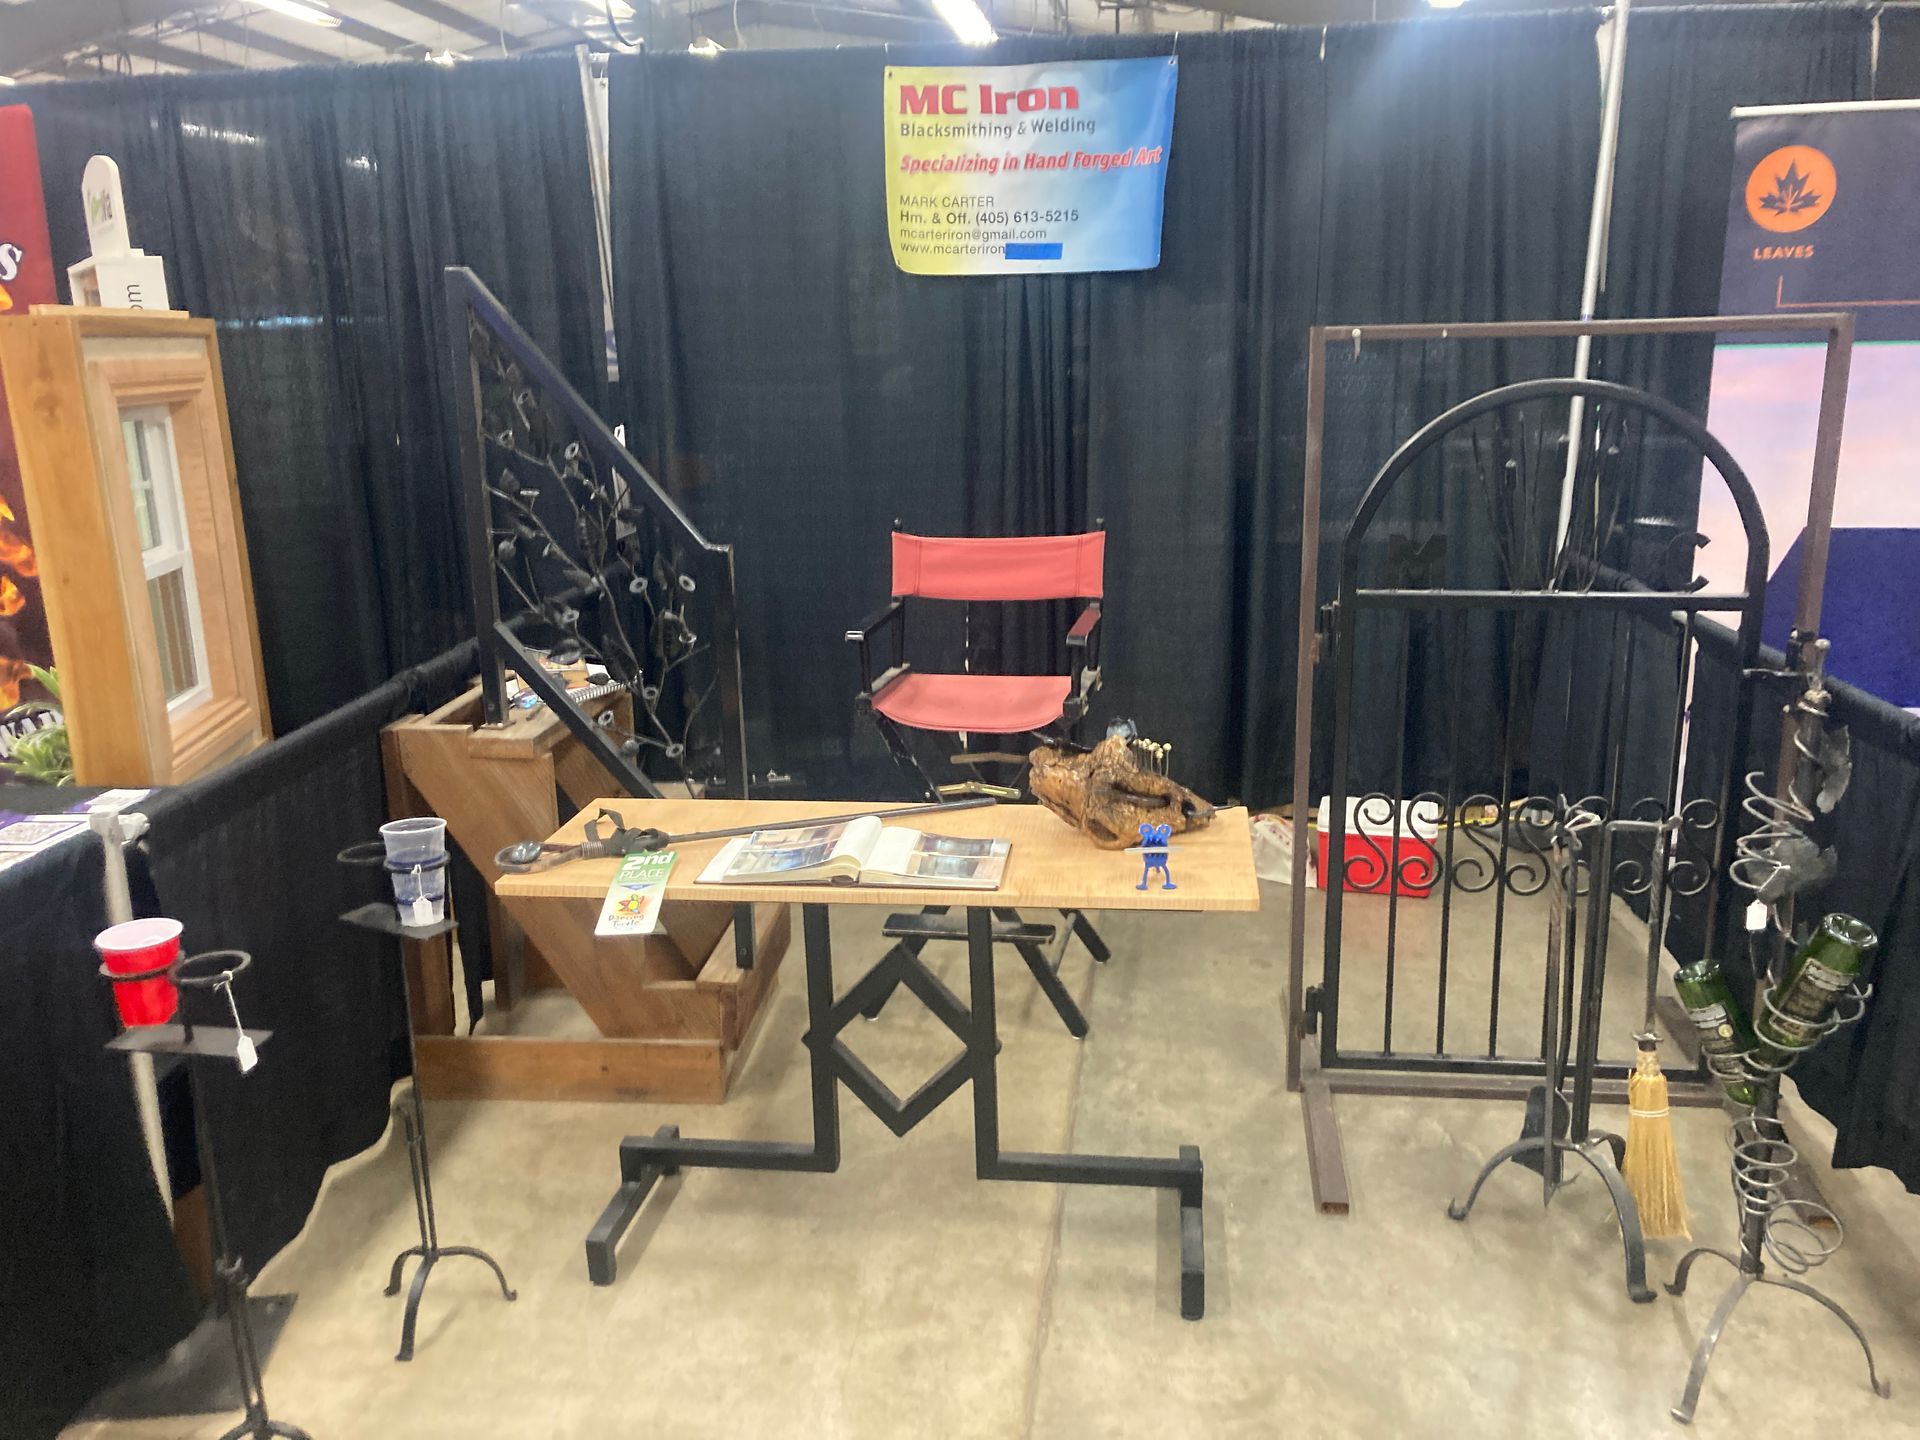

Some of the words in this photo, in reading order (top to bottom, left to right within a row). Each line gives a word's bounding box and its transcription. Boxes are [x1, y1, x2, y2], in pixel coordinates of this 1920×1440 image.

[900, 84, 967, 115] MC
[979, 84, 1080, 115] Iron
[901, 122, 1012, 139] Blacksmithing
[1017, 121, 1026, 135] &
[1031, 116, 1096, 135] Welding
[900, 152, 999, 176] Specializing
[1002, 151, 1019, 171] in
[1023, 151, 1069, 171] Hand
[1073, 147, 1132, 172] Forged
[1135, 146, 1163, 165] Art
[900, 194, 937, 208] MARK
[942, 196, 994, 208] CARTER
[900, 210, 927, 224] Hm.
[931, 212, 941, 225] &
[946, 212, 971, 225] Off.
[975, 211, 1009, 227] (405)
[1013, 209, 1079, 224] 613-5215
[900, 228, 1047, 242] mcarteriron@gmail.com
[1754, 244, 1814, 260] LEAVES
[621, 850, 676, 871] 2nd
[619, 868, 665, 880] PLACE
